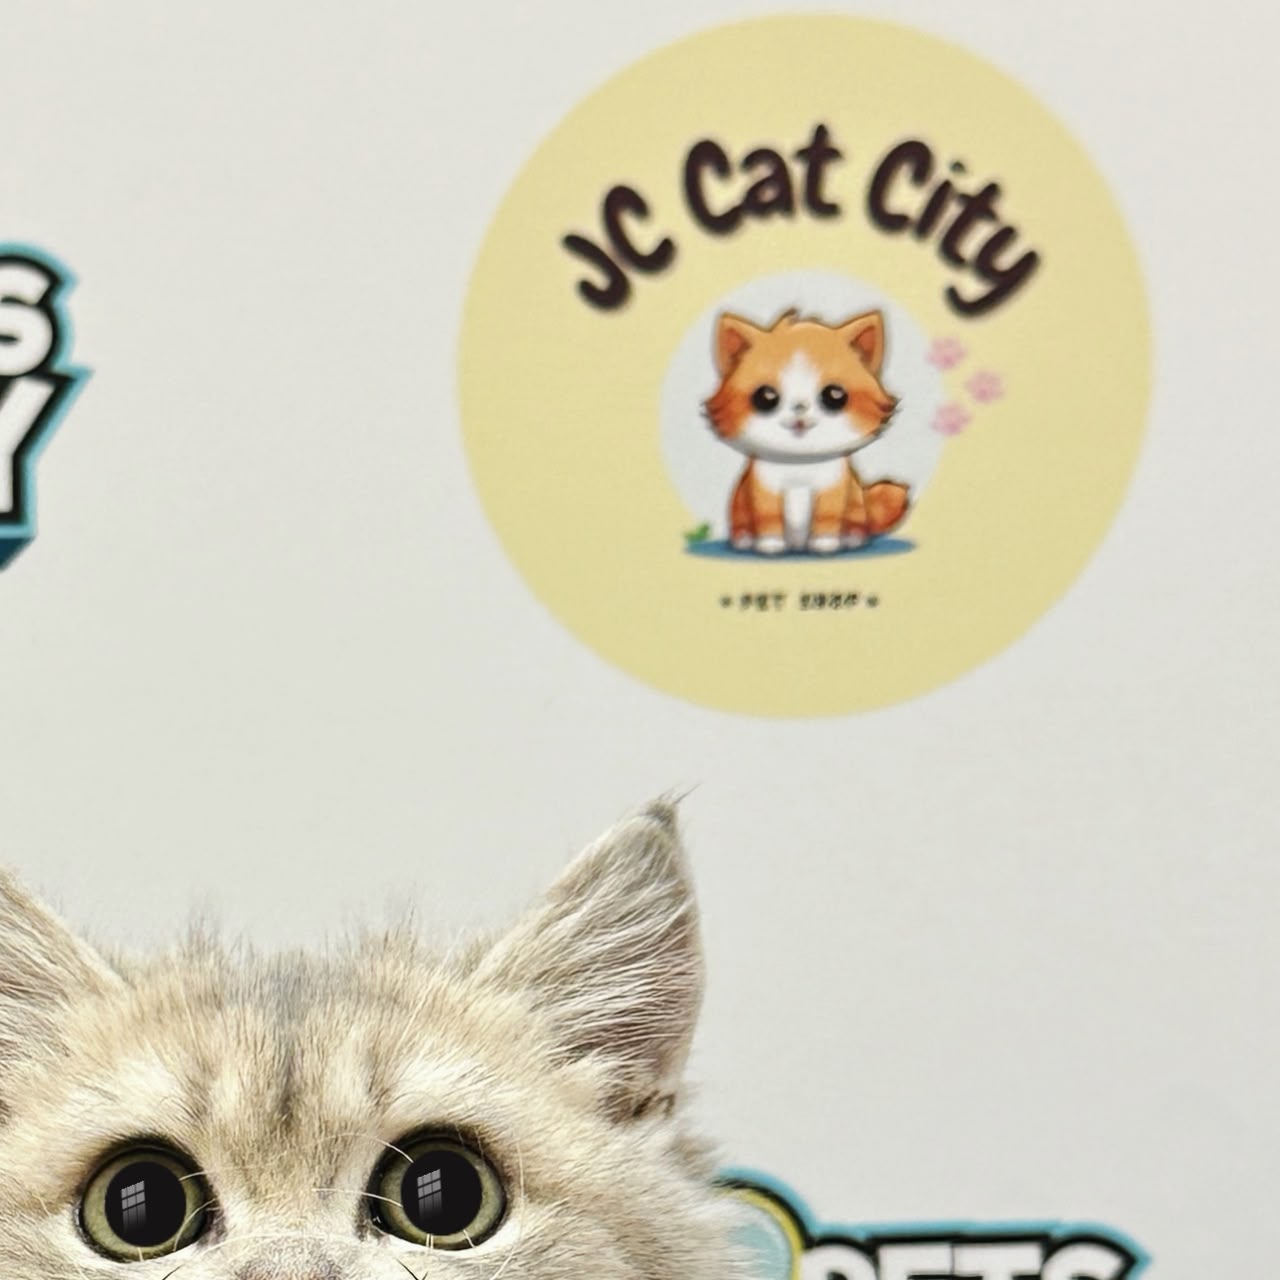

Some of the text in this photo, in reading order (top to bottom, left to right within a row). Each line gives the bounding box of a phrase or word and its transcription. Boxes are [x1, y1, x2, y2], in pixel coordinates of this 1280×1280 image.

[562, 124, 1041, 317] JC Cat City
